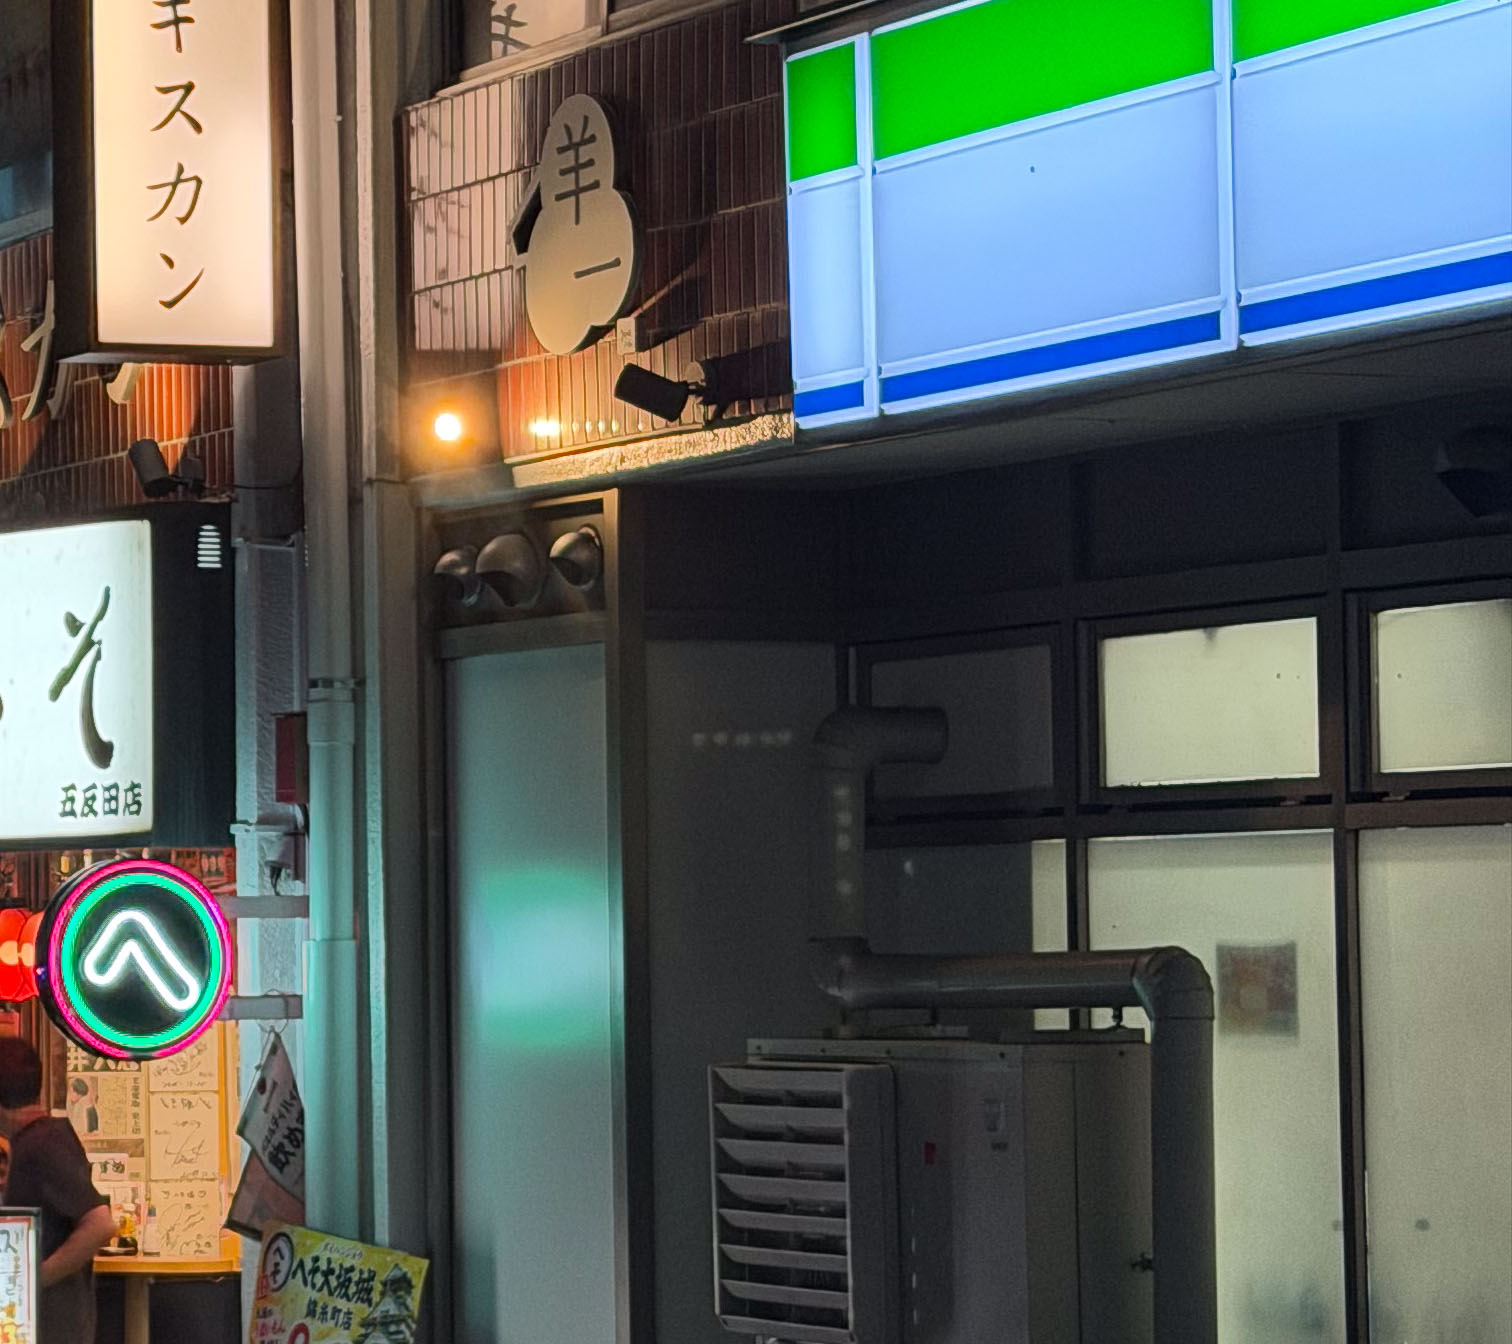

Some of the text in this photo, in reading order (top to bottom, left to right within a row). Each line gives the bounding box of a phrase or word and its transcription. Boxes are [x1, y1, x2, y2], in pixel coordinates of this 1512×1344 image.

[554, 115, 622, 279] 羊一
[58, 779, 143, 819] 五反田店
[270, 1244, 286, 1285] へそ
